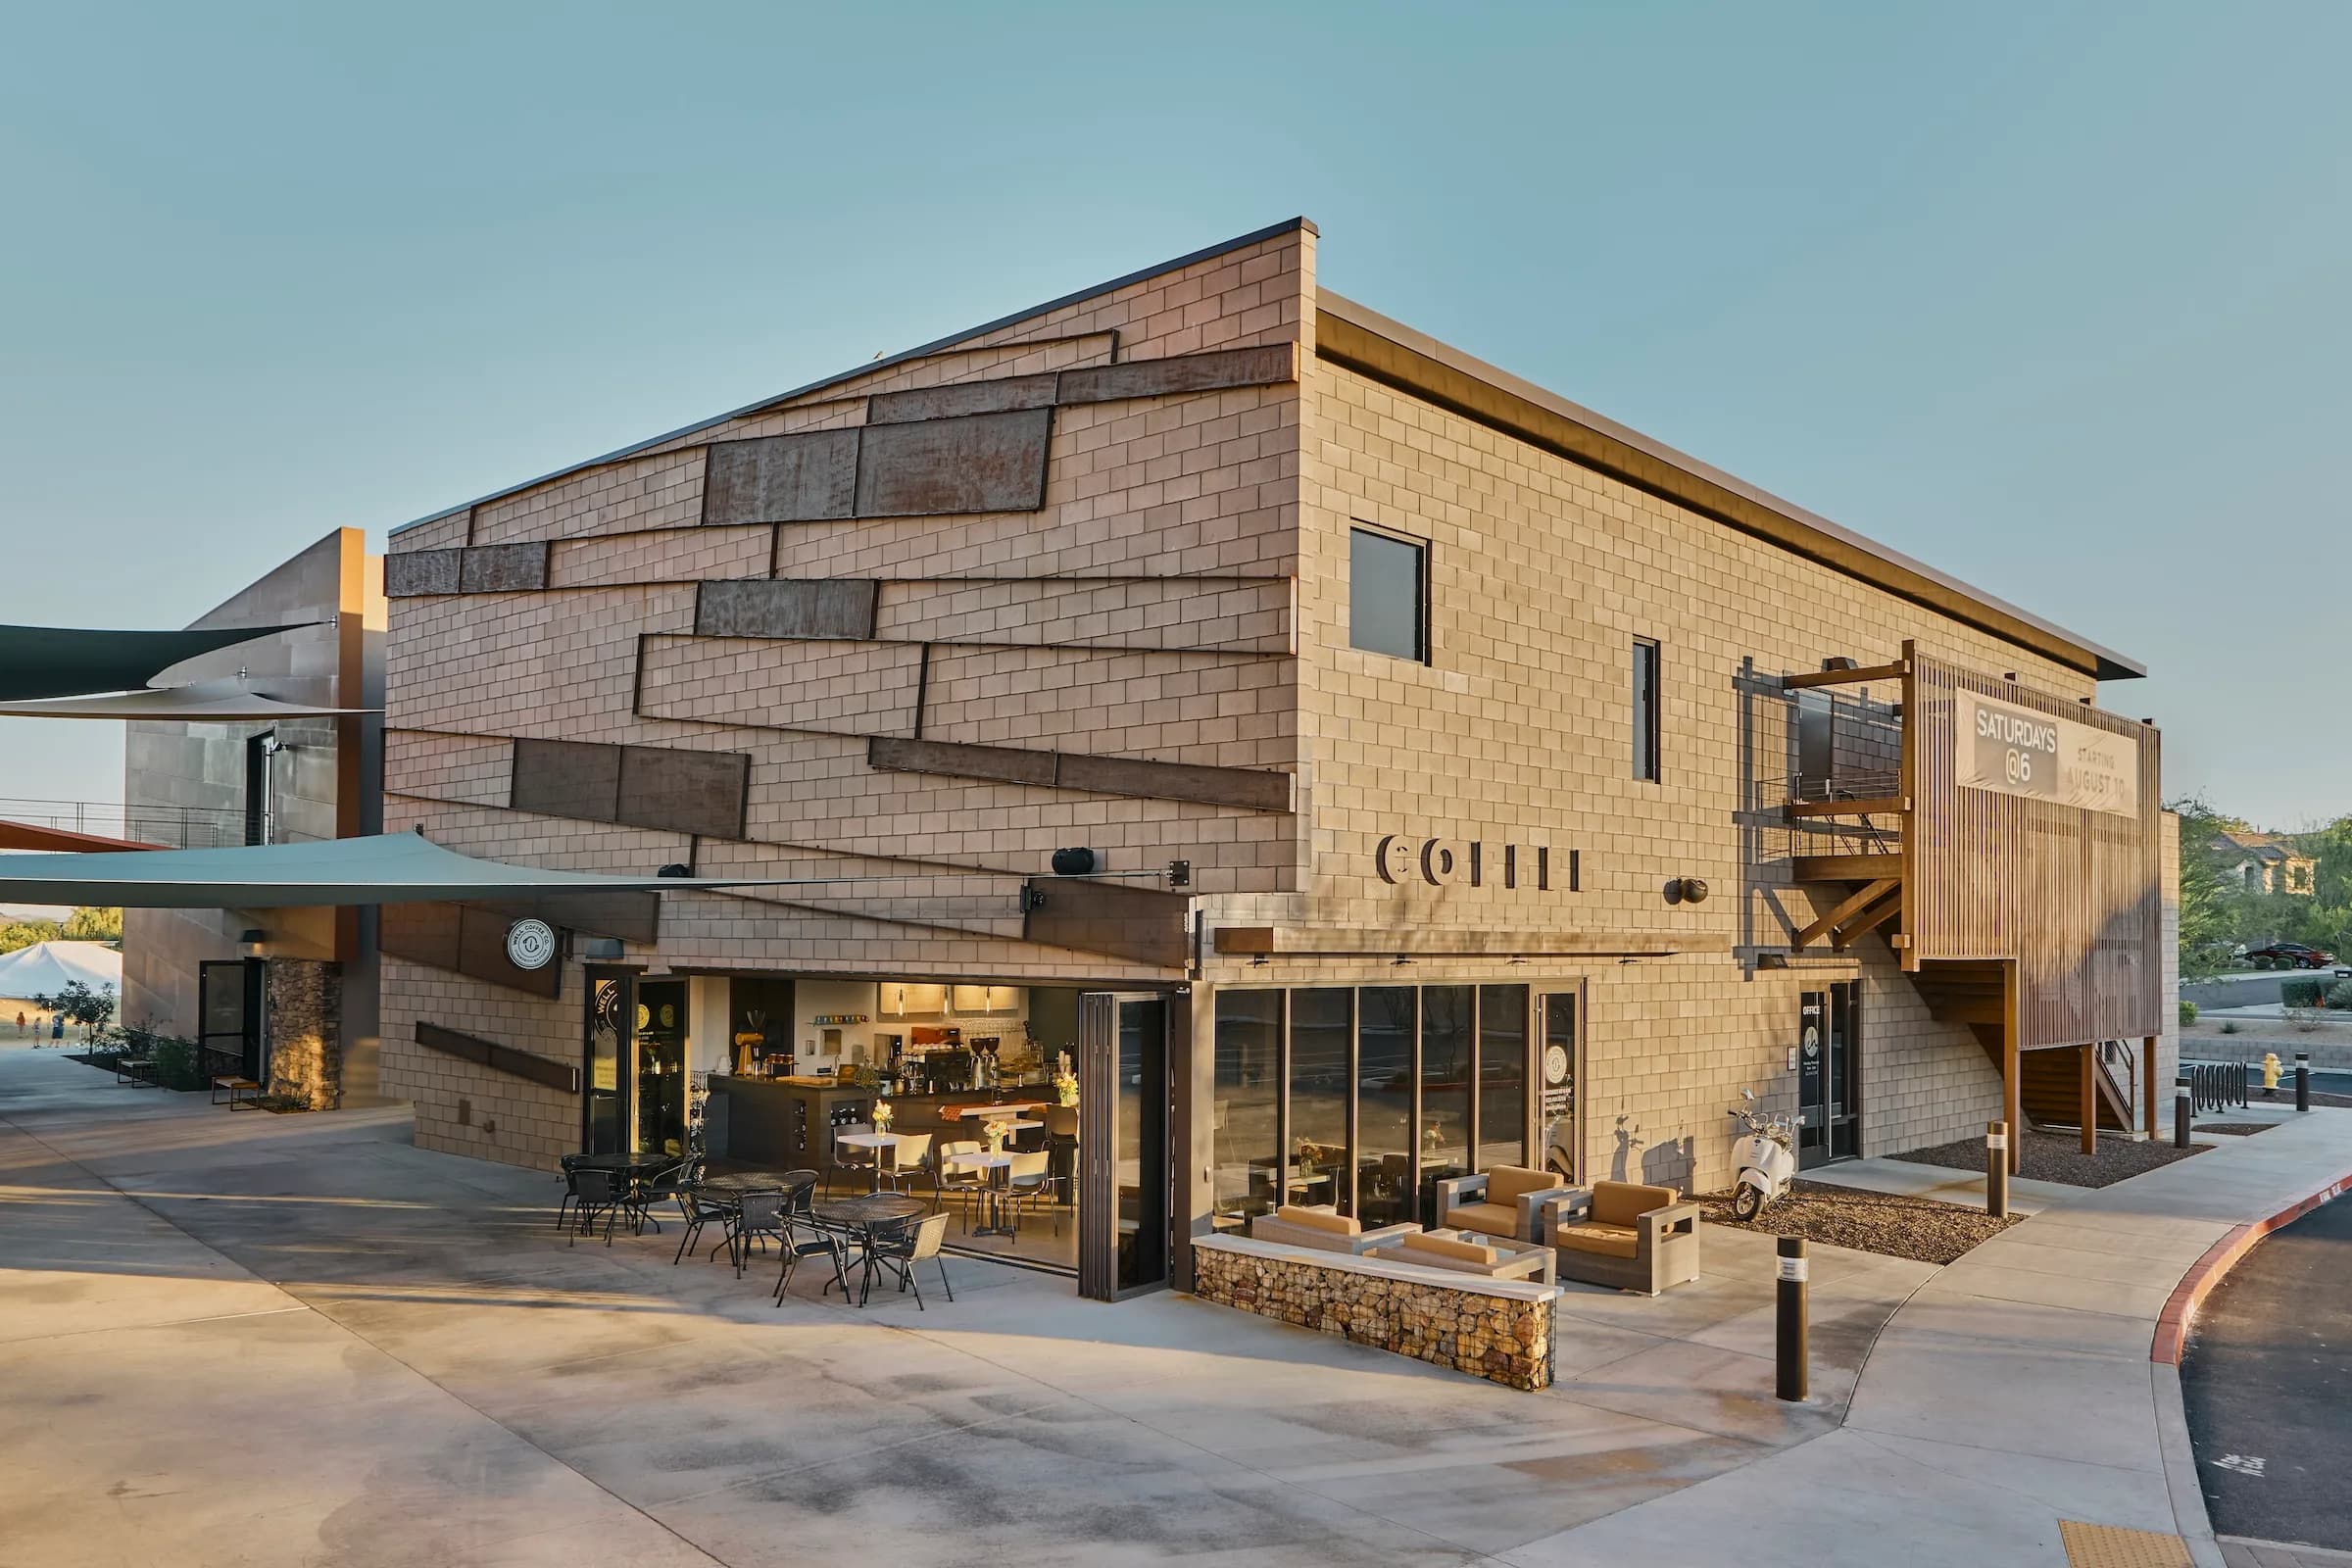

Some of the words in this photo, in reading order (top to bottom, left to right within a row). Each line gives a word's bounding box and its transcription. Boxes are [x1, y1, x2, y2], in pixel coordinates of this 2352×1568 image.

[1977, 709, 2056, 753] SATURDAYS
[2005, 748, 2032, 785] @6
[2078, 747, 2115, 769] STARTING
[2069, 766, 2111, 794] AUGUST
[513, 929, 524, 945] WELL
[524, 924, 545, 935] COFFEE
[597, 989, 615, 1014] WELL
[1803, 1004, 1821, 1015] OFFICE
